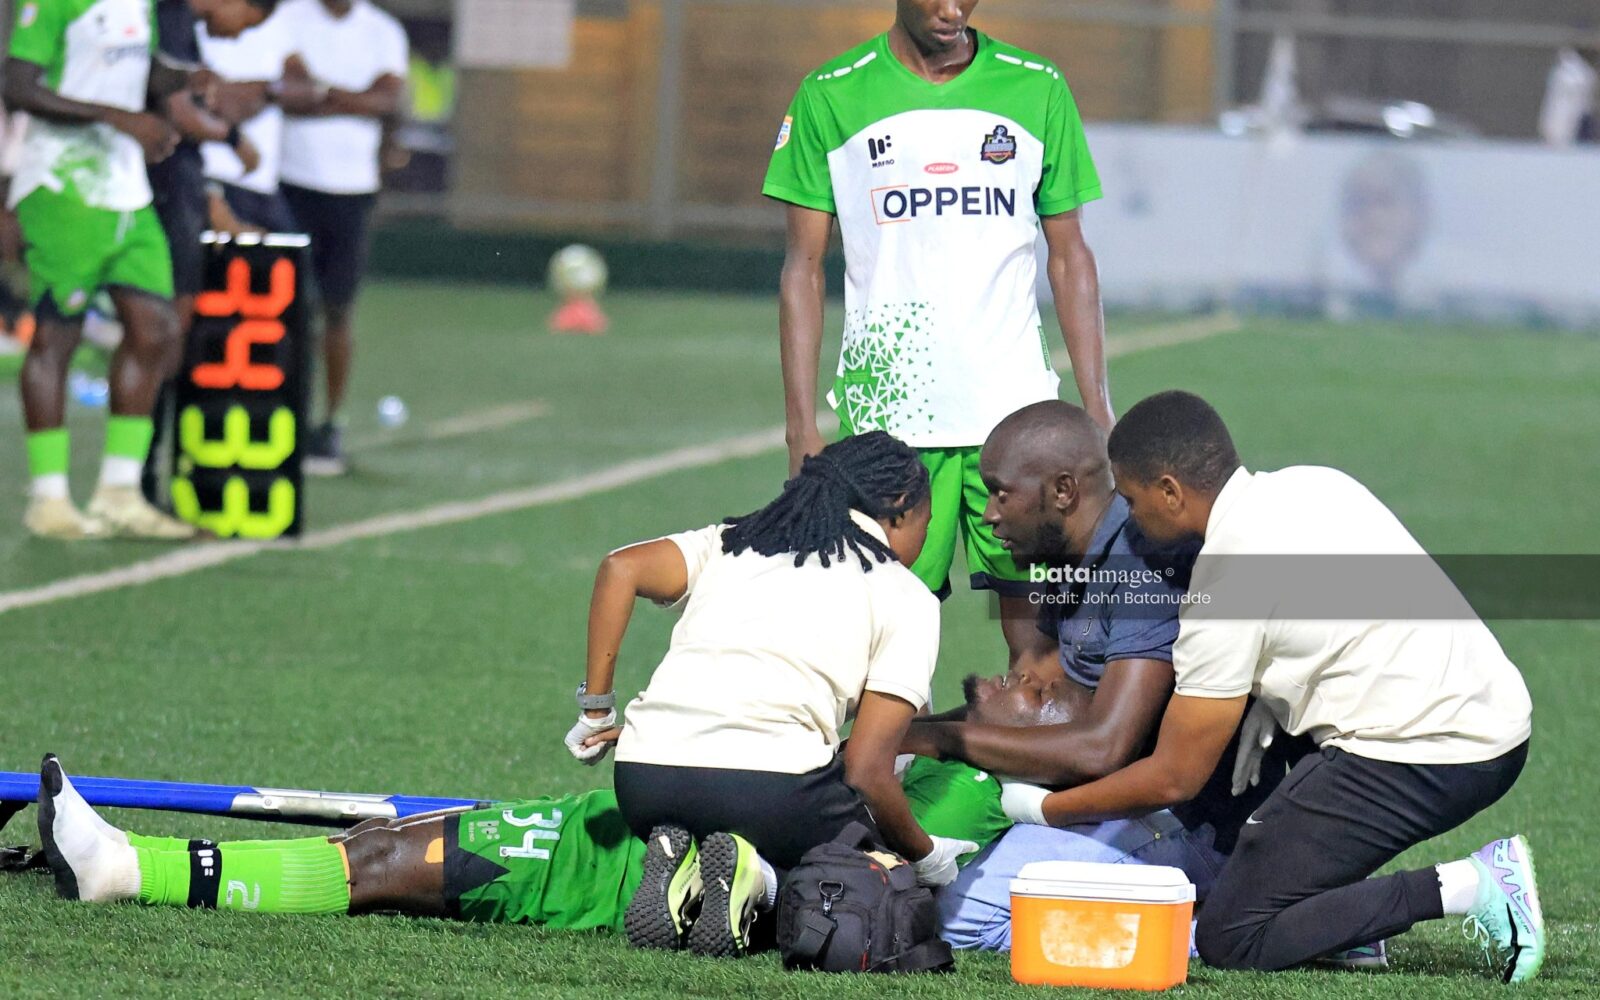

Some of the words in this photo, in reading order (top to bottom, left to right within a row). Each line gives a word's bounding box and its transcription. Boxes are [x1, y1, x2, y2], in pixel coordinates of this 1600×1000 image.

[883, 186, 1016, 219] OPPEIN
[171, 403, 296, 539] 33
[499, 808, 563, 860] 34
